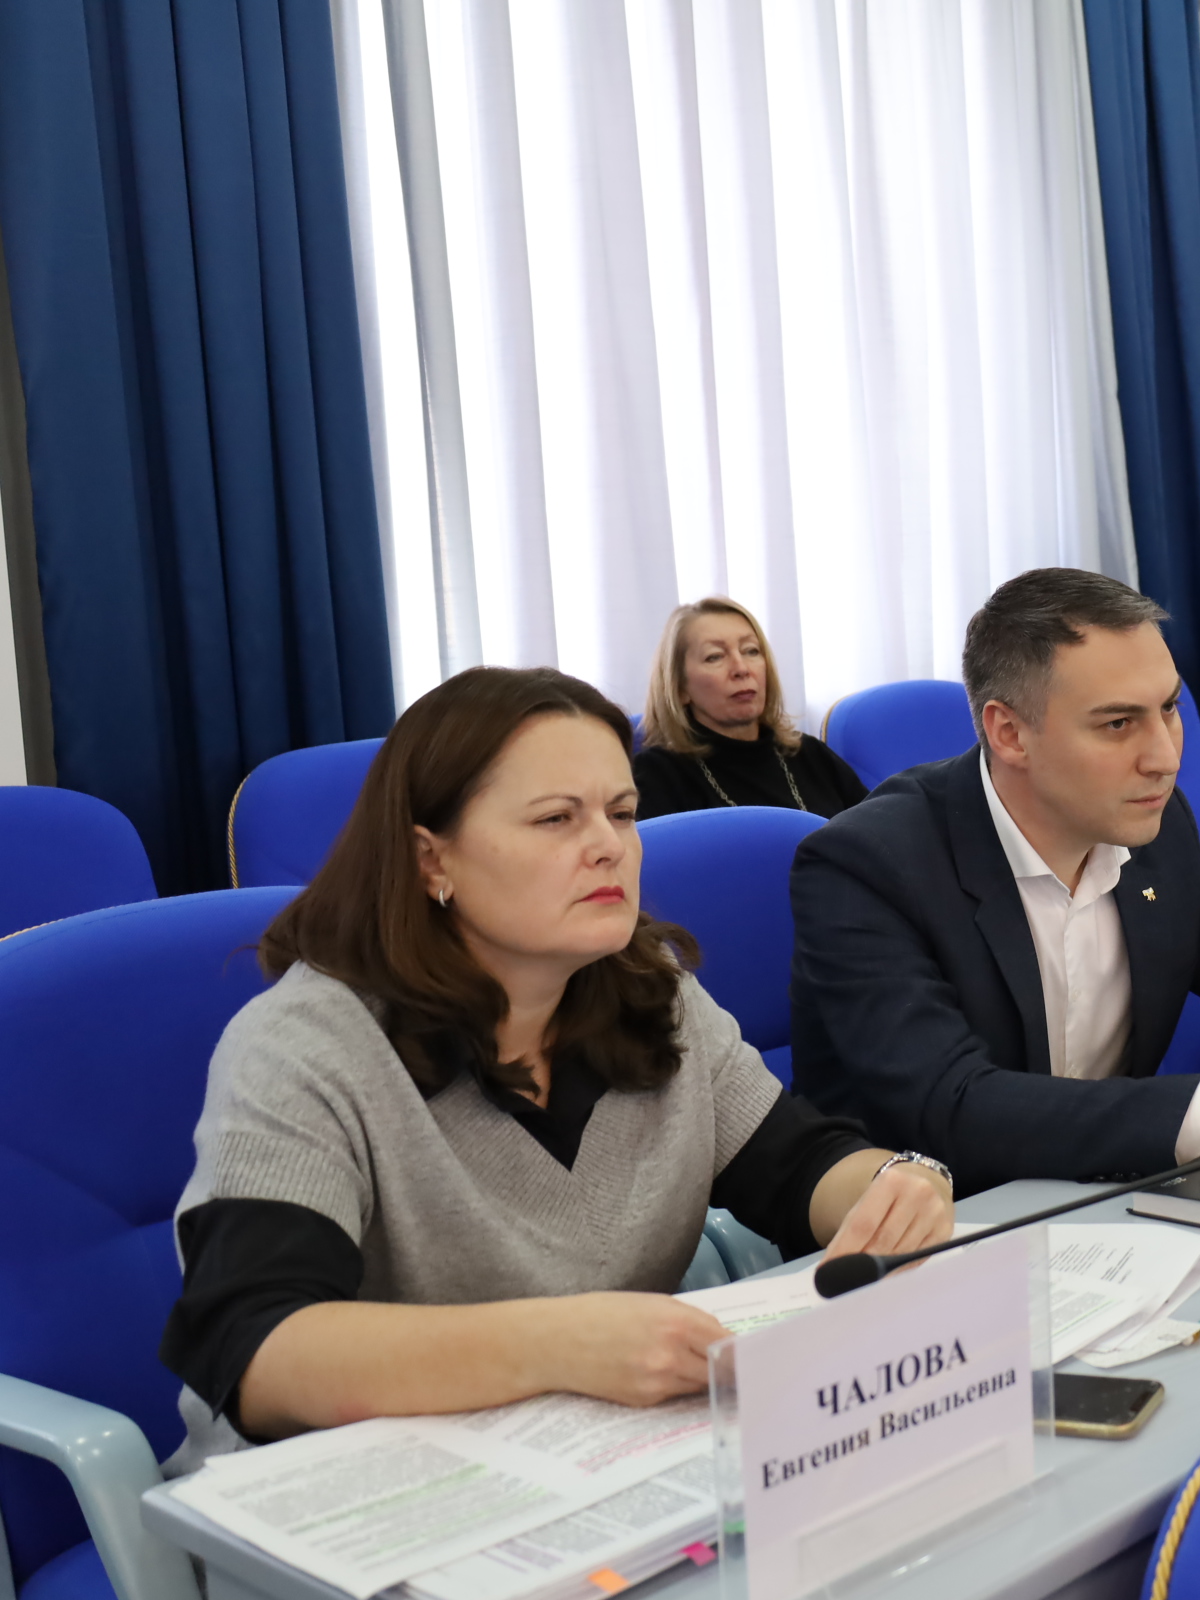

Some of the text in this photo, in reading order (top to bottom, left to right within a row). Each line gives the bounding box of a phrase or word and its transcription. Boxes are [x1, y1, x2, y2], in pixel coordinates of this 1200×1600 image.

[816, 1338, 968, 1417] ЧАЛОВА
[760, 1427, 871, 1490] Евгения
[879, 1367, 1018, 1440] Васильевна
